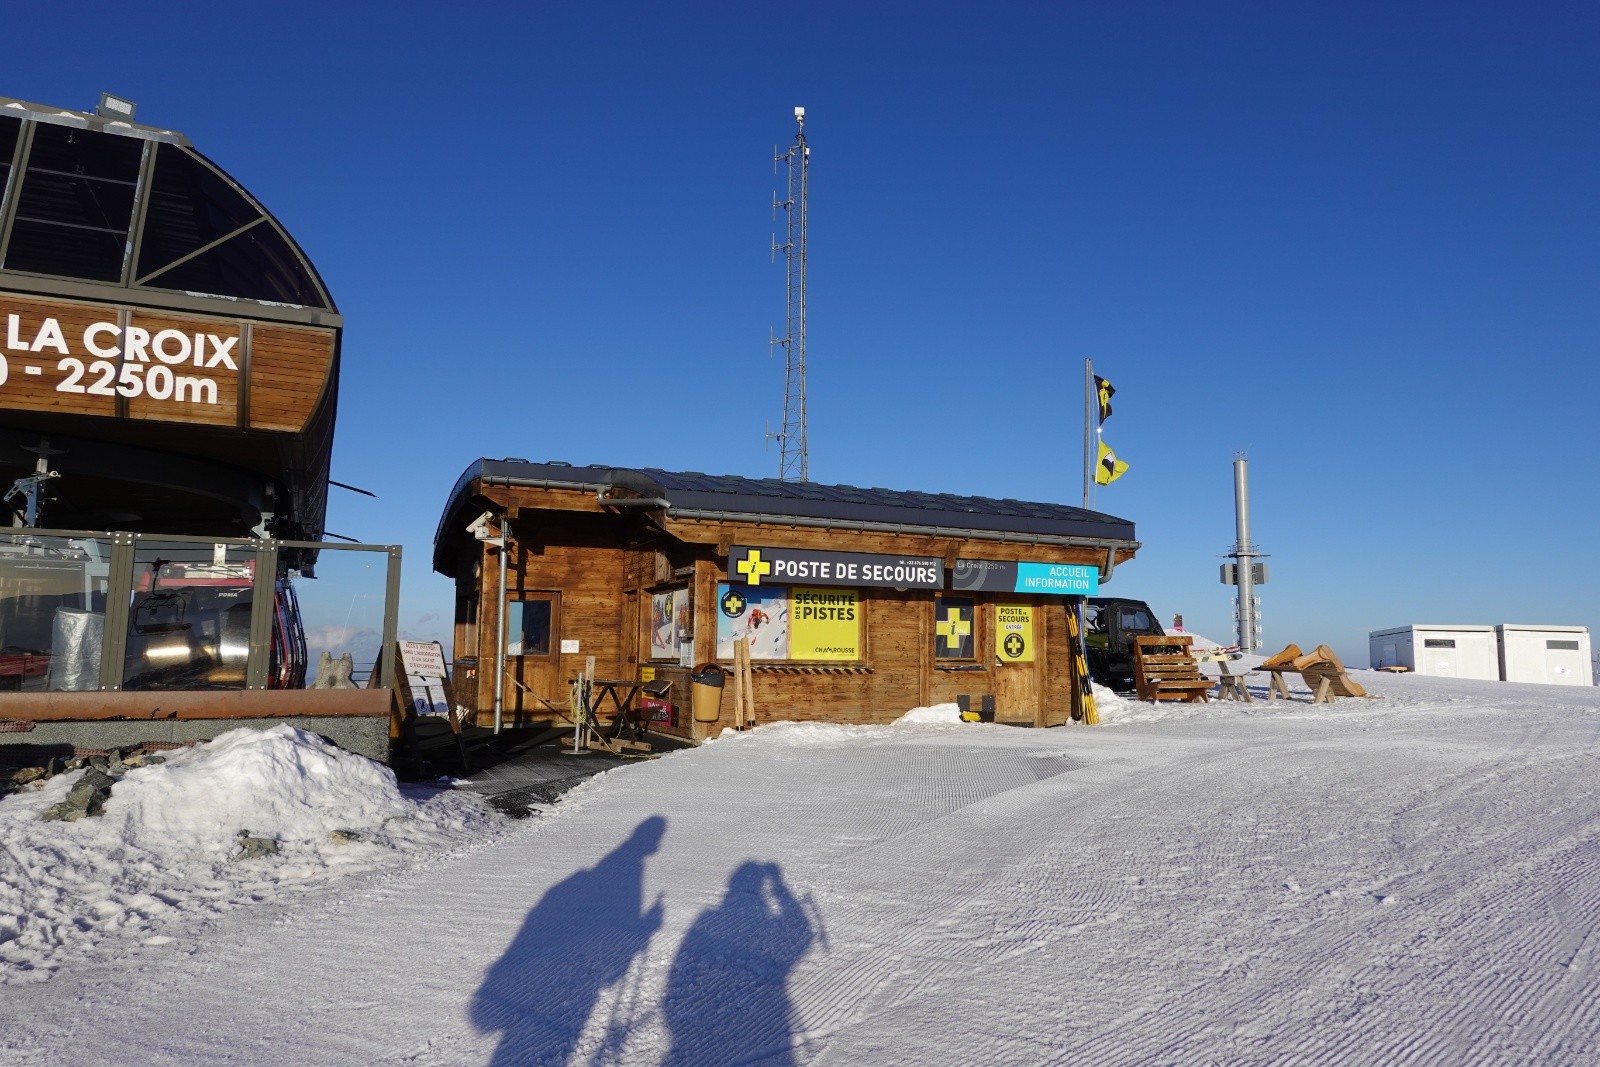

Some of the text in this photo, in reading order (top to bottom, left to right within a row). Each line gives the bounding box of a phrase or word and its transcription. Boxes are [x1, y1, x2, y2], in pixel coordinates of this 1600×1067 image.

[8, 314, 239, 370] LA CROIX
[56, 357, 217, 404] 2250m
[775, 559, 937, 583] POSTE DE SECOURS
[966, 561, 983, 569] Croix
[1049, 566, 1090, 578] ACCUEIL
[1025, 577, 1089, 590] INFORMATION
[795, 591, 855, 606] SÉCURITÉ
[803, 606, 855, 621] PISTES
[1000, 607, 1022, 615] POSTE
[998, 615, 1030, 623] SECOURS
[815, 646, 855, 654] CHAMROUSSE
